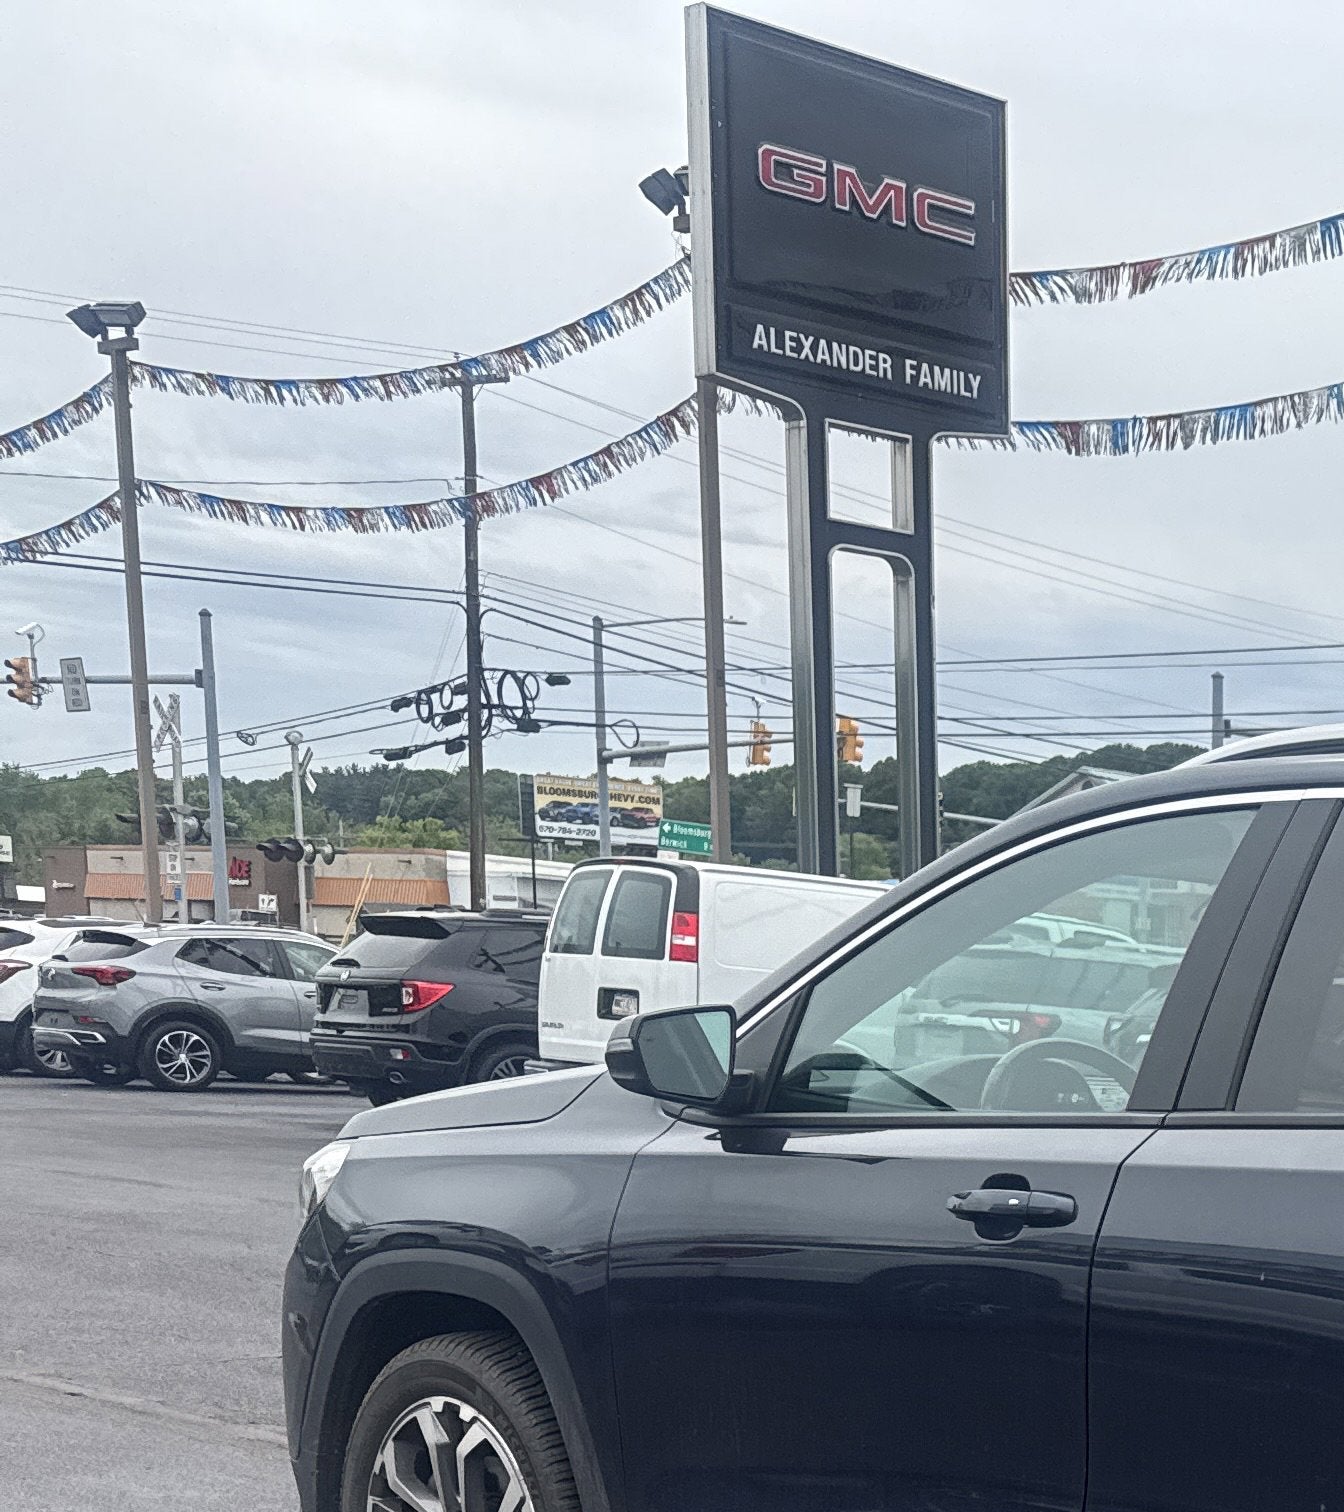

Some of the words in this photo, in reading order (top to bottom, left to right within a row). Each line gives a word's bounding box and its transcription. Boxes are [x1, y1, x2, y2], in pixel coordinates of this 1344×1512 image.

[757, 143, 976, 246] GMC
[752, 323, 893, 381] ALEXANDER
[904, 358, 982, 400] FAMILY
[536, 785, 661, 805] BLOOMSBURHEVY.COM
[228, 856, 252, 878] ACE
